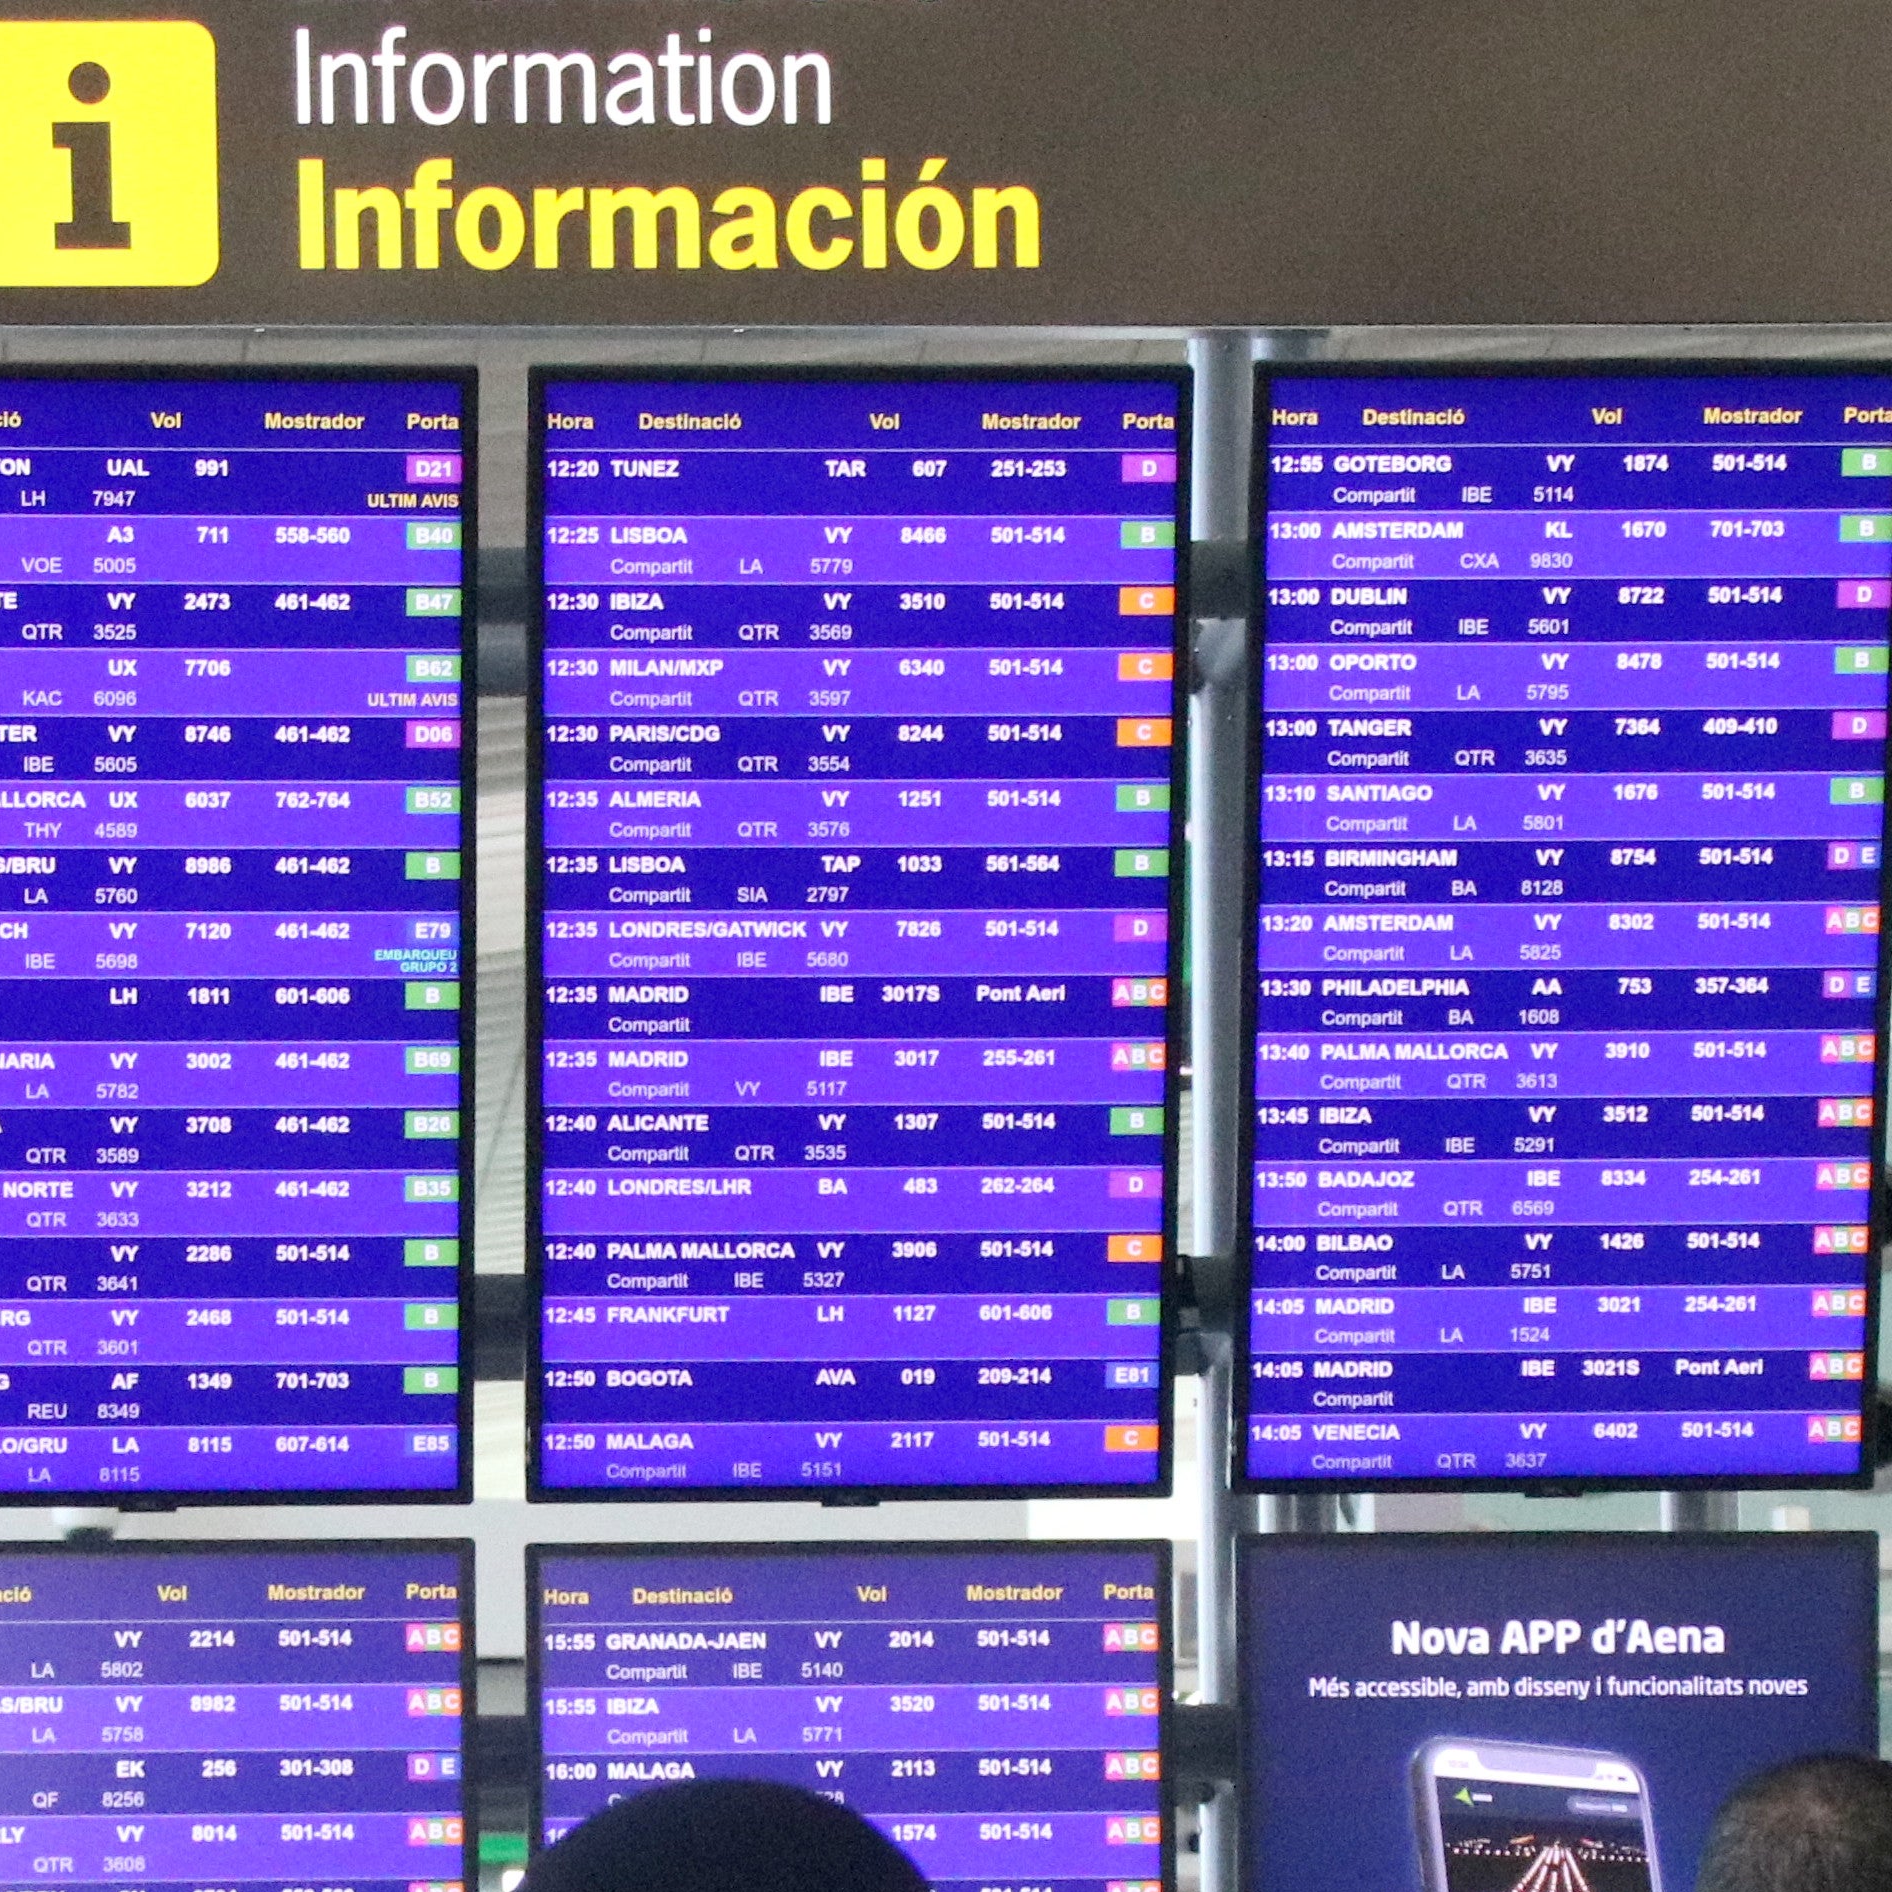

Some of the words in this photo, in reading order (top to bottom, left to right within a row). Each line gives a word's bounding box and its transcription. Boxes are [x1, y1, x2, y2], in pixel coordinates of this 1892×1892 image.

[296, 26, 831, 126] Information
[298, 158, 1039, 270] Información
[151, 412, 181, 428] Vol
[265, 412, 365, 429] Mostrador
[407, 413, 459, 429] Porta
[547, 413, 594, 429] Hora
[639, 413, 742, 430] Destinació
[869, 413, 900, 429] Vol
[982, 413, 1081, 429] Mostrador
[1123, 413, 1175, 429] Porta
[1272, 409, 1318, 425] Hora
[1363, 408, 1465, 425] Destinació
[1592, 408, 1622, 424] Vol
[1704, 407, 1803, 424] Mostrador
[107, 459, 150, 476] UAL
[195, 459, 228, 476] 991
[415, 460, 451, 477] D21
[548, 460, 599, 477] 12:20
[611, 460, 679, 477] TUNEZ
[825, 460, 866, 477] TAR
[912, 460, 947, 477] 607
[991, 460, 1066, 477] 251-253
[1142, 460, 1157, 477] D
[1272, 455, 1323, 473] 12:55
[1334, 455, 1452, 473] GOTEBORG
[1547, 455, 1575, 472] VY
[1623, 454, 1669, 471] 1874
[1712, 454, 1787, 471] 501-514
[1862, 454, 1876, 470] B
[21, 490, 45, 506] LH
[93, 490, 135, 506] 7947
[368, 493, 417, 508] ULTIM
[421, 494, 459, 507] AVIS
[1266, 719, 1317, 736] 13:00
[1328, 719, 1411, 736] TANGER
[1539, 719, 1567, 736] VY
[1615, 718, 1660, 735] 7364
[1703, 718, 1778, 734] 409-410
[1852, 717, 1867, 734] D
[111, 1373, 139, 1389] AF
[188, 1373, 232, 1389] 1349
[276, 1372, 349, 1389] 701-703
[420, 1372, 438, 1388] B
[545, 1370, 595, 1387] 12:50
[607, 1370, 693, 1387] BOGOTA
[816, 1369, 856, 1385] AVA
[901, 1368, 935, 1384] 019
[978, 1367, 1051, 1384] 209-214
[1115, 1367, 1148, 1384] E81
[157, 1585, 187, 1601] Vol
[268, 1584, 365, 1600] Mostrador
[406, 1583, 457, 1599] Porta
[544, 1589, 589, 1605] Hora
[632, 1588, 733, 1604] Destinació
[857, 1586, 887, 1602] Vol
[966, 1585, 1063, 1601] Mostrador
[1103, 1583, 1154, 1599] Porta
[545, 1633, 595, 1650] 15:55
[606, 1632, 766, 1650] GRANADA-JAEN
[815, 1631, 842, 1648] VY
[889, 1631, 934, 1648] 2014
[977, 1629, 1050, 1646] 501-514
[1392, 1621, 1489, 1654] Nova
[1500, 1620, 1581, 1654] APP
[1309, 1677, 1350, 1697] Més
[1355, 1677, 1461, 1698] accessible,
[1467, 1677, 1509, 1696] amb
[1514, 1677, 1590, 1700] disseny
[1595, 1676, 1601, 1695] i
[1606, 1676, 1743, 1696] funcionalitats
[1748, 1679, 1808, 1695] noves
[116, 1760, 144, 1778] EK
[202, 1759, 236, 1777] 256
[280, 1759, 353, 1776] 301-308
